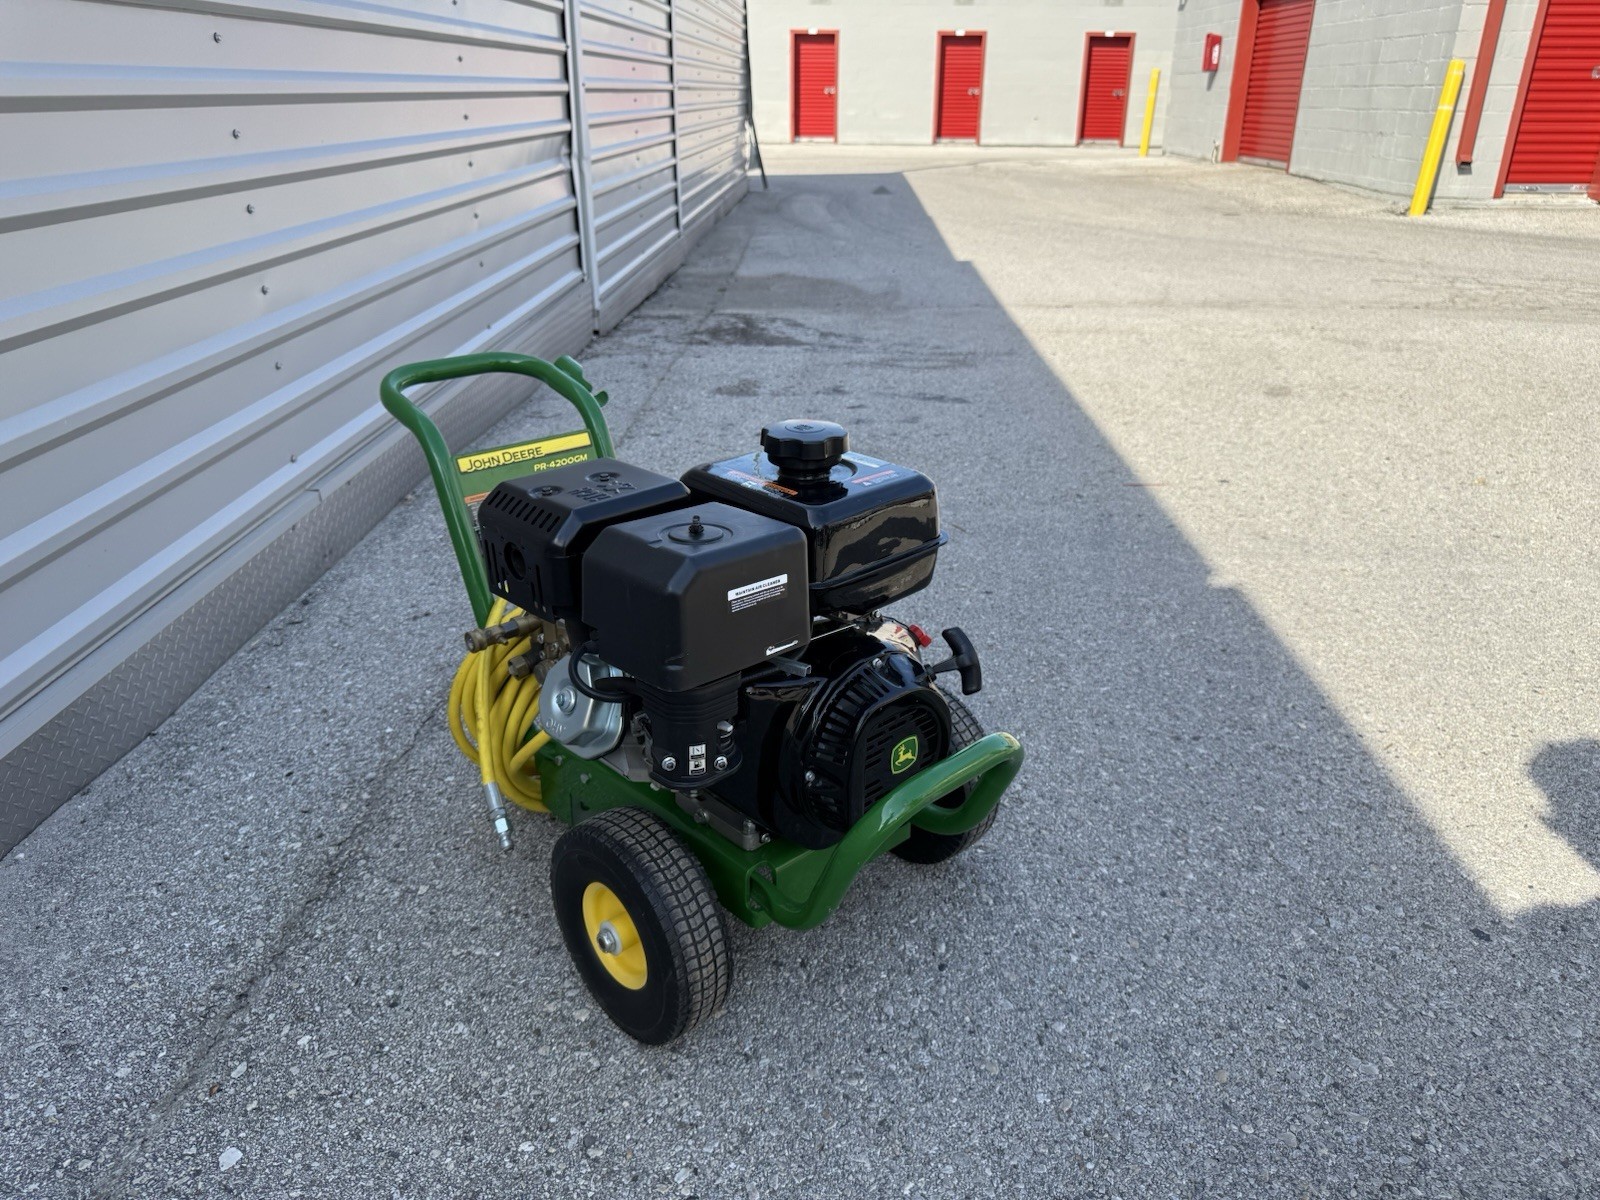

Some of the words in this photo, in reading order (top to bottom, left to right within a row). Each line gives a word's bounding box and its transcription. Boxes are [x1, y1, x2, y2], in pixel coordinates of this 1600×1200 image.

[467, 456, 501, 471] JOHN
[502, 446, 543, 463] DEERE
[533, 453, 588, 472] PR-4200GM
